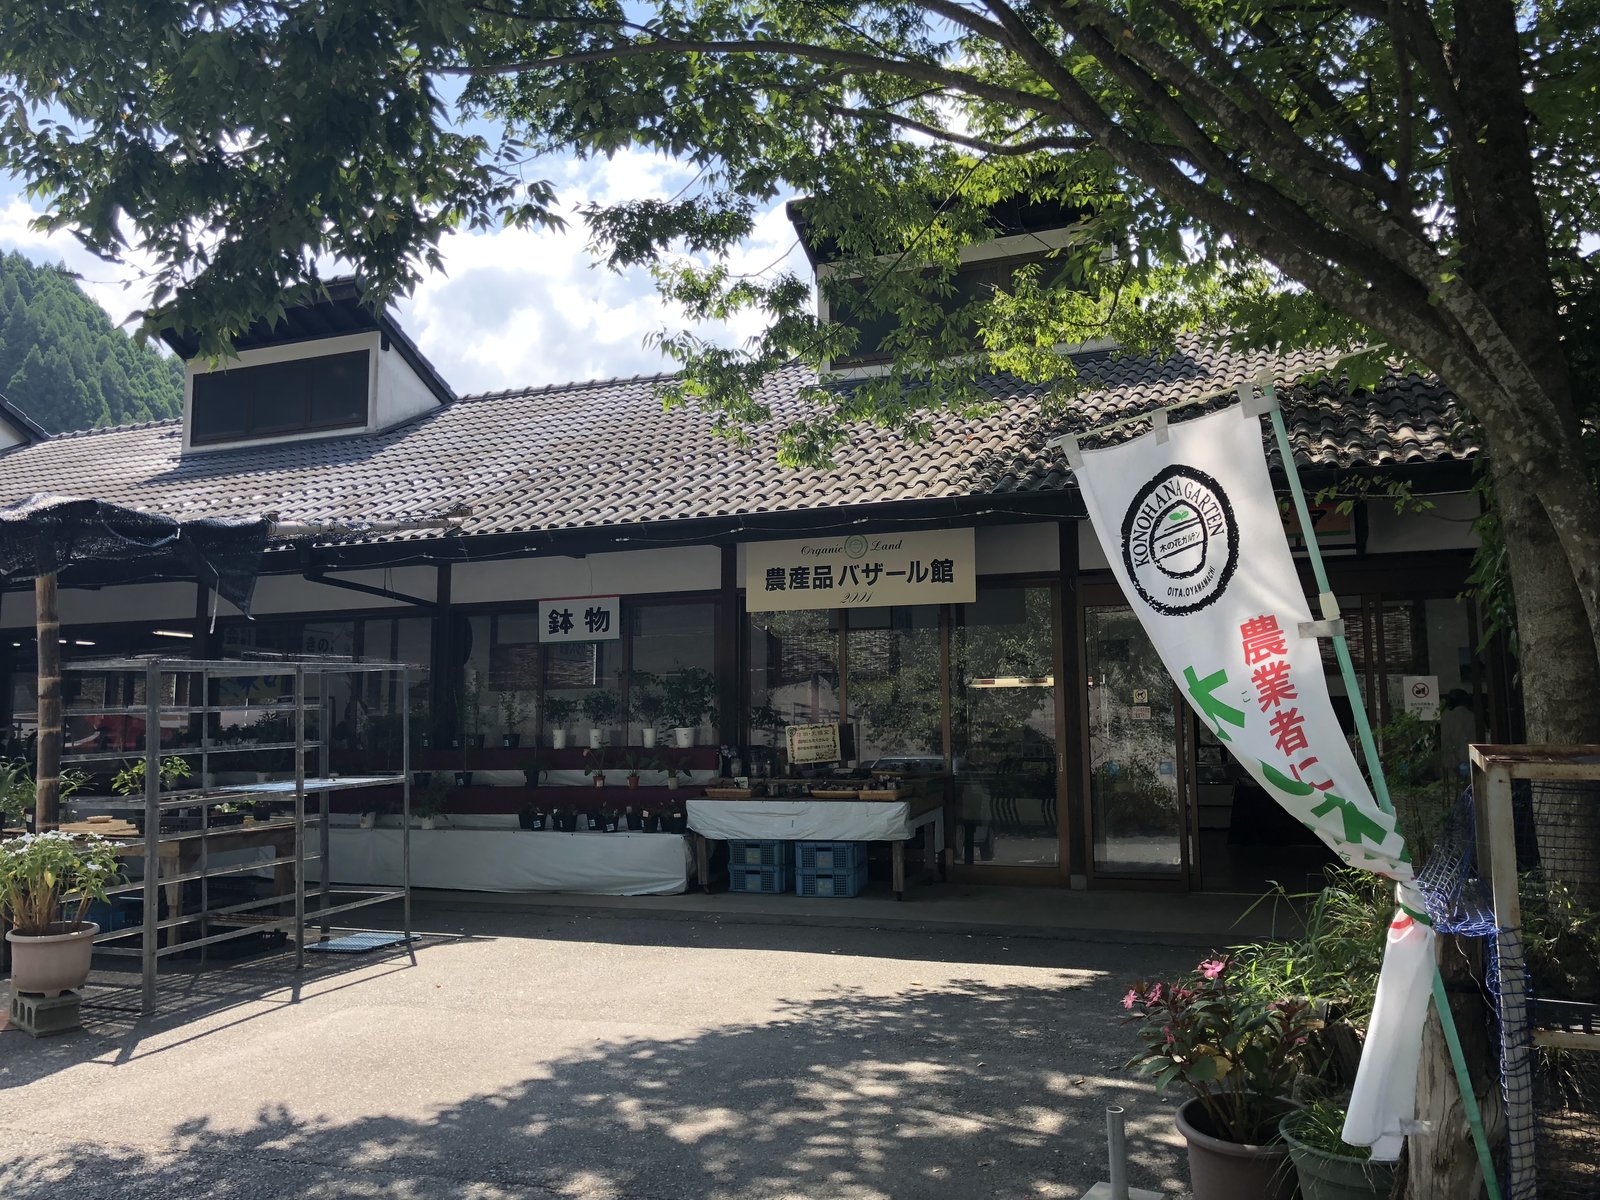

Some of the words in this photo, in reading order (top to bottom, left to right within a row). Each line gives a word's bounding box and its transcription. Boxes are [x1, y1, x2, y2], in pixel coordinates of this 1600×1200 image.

[1132, 479, 1183, 568] KONOHANA
[1184, 482, 1225, 537] GARTEN
[800, 544, 844, 557] Organic
[870, 540, 903, 551] Land
[1159, 531, 1201, 553] 木の花ガルテン
[765, 559, 954, 592] 農産品バザール館
[548, 606, 610, 635] 鉢物
